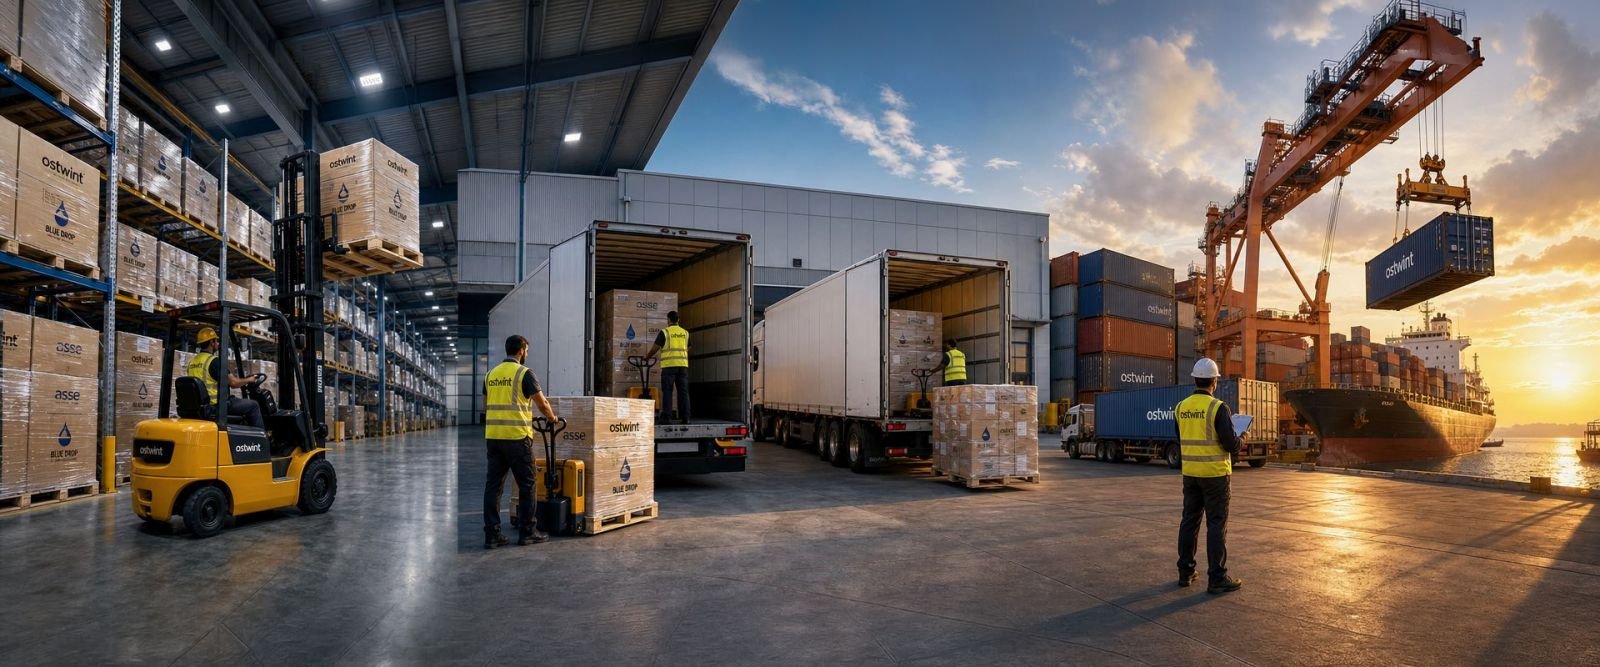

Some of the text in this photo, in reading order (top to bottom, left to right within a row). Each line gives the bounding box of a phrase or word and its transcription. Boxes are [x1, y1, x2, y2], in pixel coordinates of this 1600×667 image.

[329, 154, 356, 169] ostwint
[41, 156, 83, 184] ostwint
[45, 224, 60, 237] BLUE
[60, 230, 76, 241] DROP
[1385, 251, 1414, 278] ostwint
[56, 341, 82, 355] asse
[488, 376, 512, 387] ostwint
[1120, 371, 1155, 385] ostwint
[54, 389, 81, 401] asse
[1146, 406, 1176, 421] ostwin
[1180, 409, 1205, 420] ostwint
[609, 421, 640, 433] ostwint
[563, 431, 586, 441] asse
[140, 446, 163, 457] ostwint
[235, 443, 261, 453] ostwint
